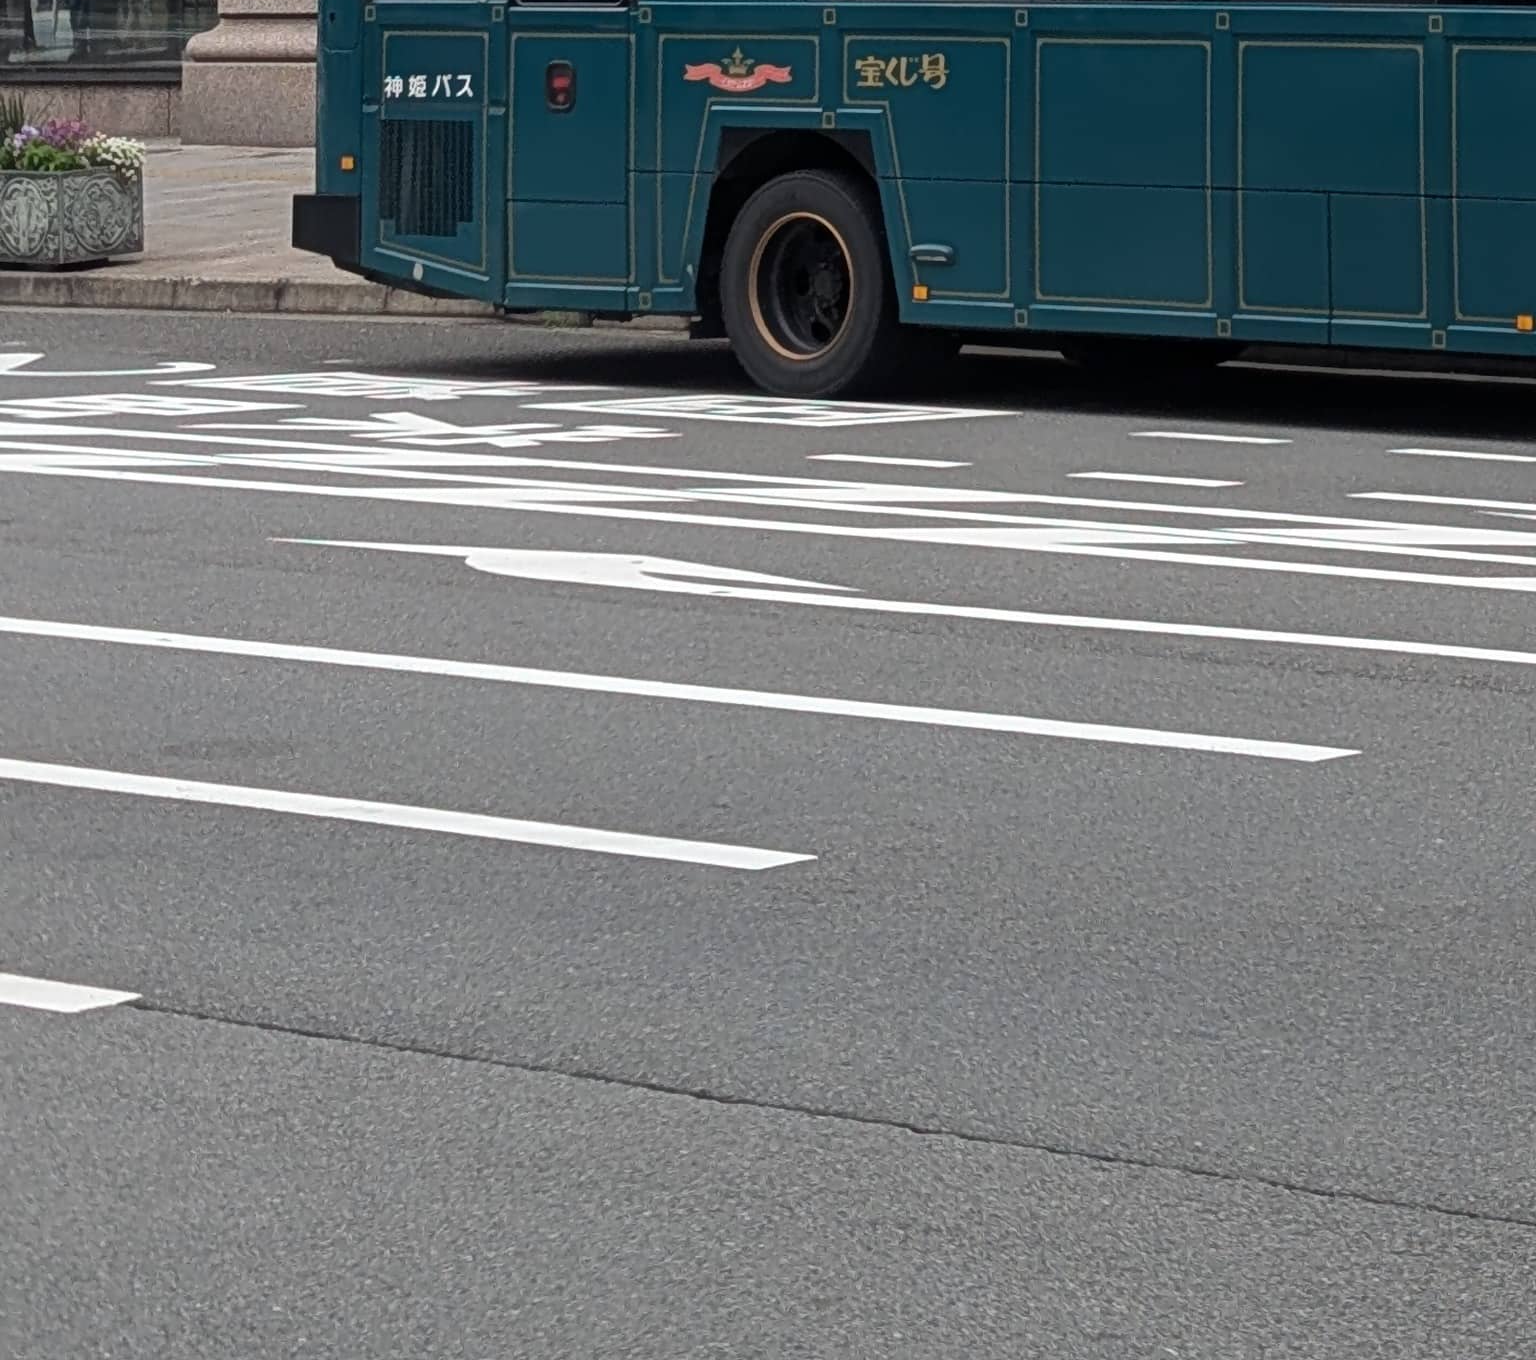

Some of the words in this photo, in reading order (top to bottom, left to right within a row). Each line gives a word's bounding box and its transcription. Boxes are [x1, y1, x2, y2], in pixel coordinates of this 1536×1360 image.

[384, 74, 475, 100] 神姫バス
[854, 53, 950, 90] 宝くじ号
